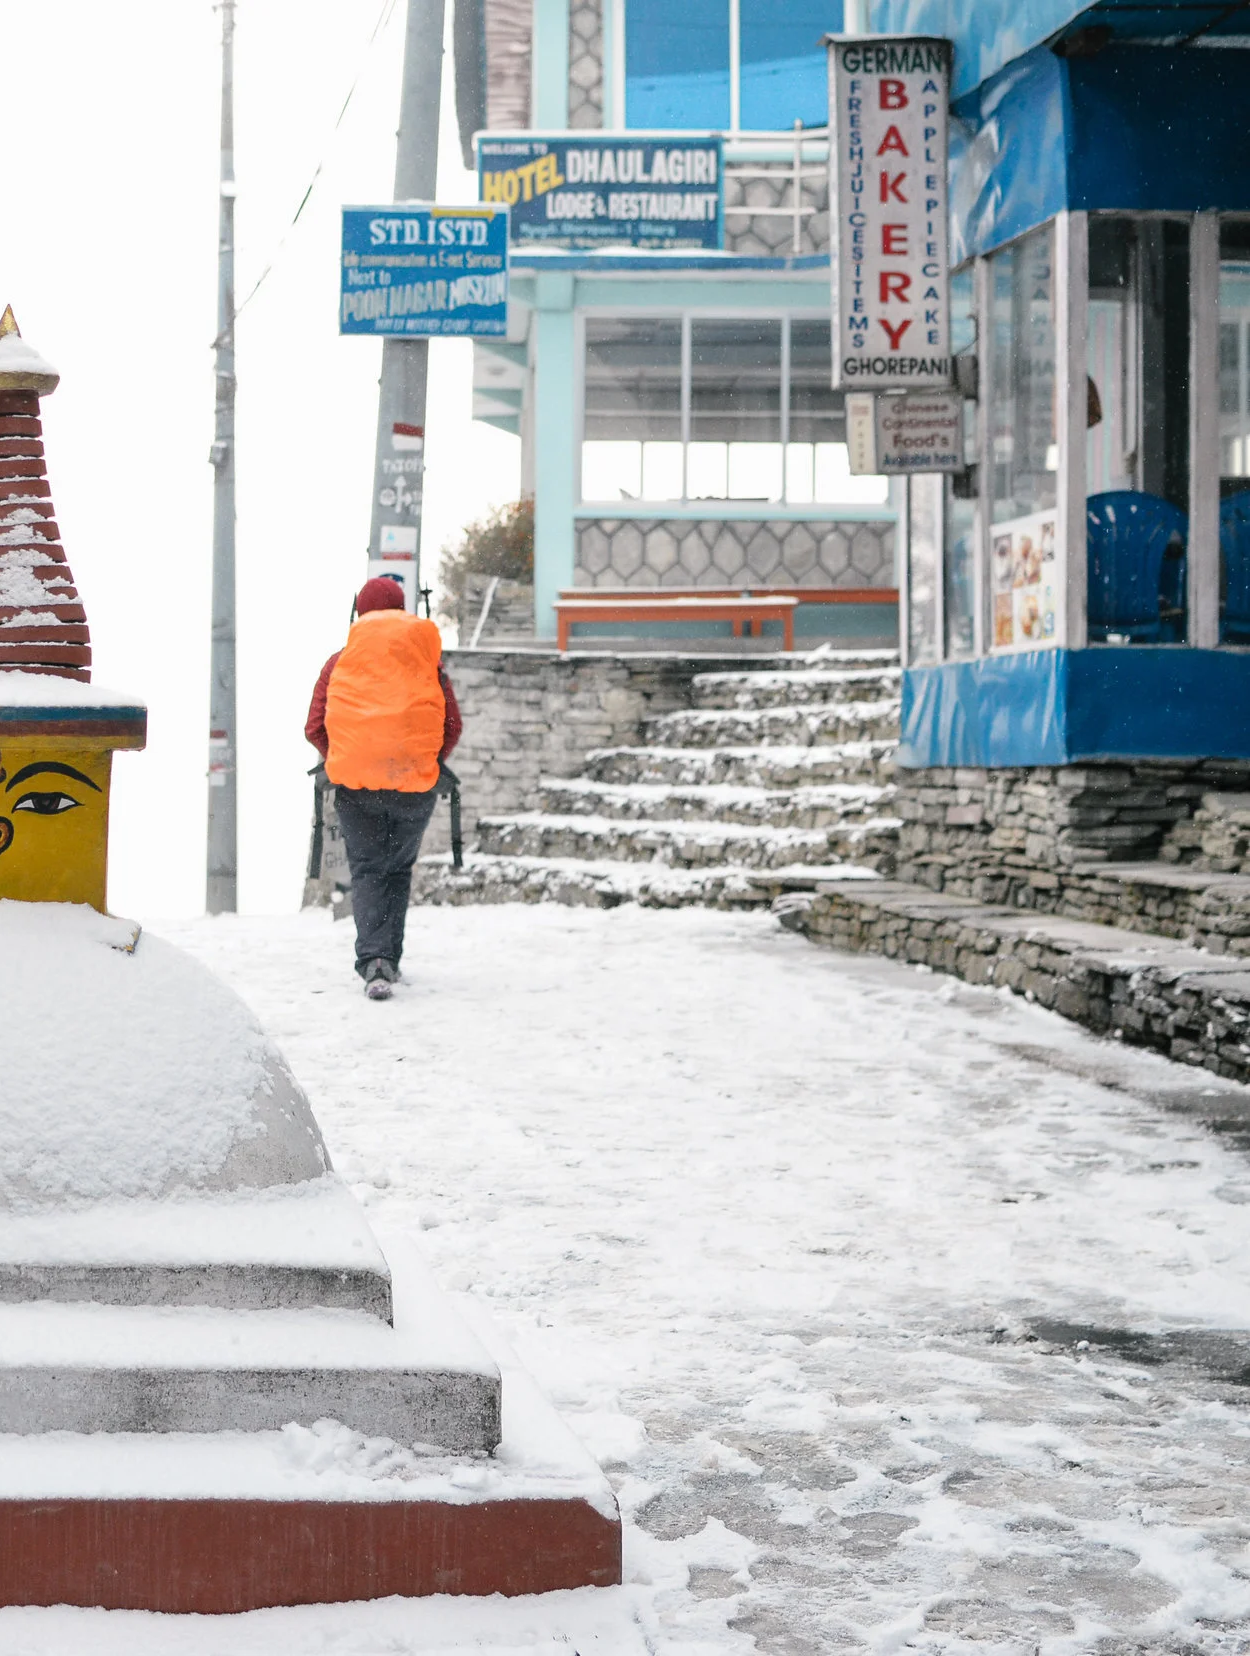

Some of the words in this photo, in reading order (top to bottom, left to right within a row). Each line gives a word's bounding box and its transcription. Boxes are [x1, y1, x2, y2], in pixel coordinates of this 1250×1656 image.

[842, 46, 943, 75] GERMAN
[482, 153, 565, 205] HOTEL
[565, 149, 718, 185] DHAULAGIRI
[545, 191, 596, 220] LODGE
[607, 191, 719, 221] RESTAURANT
[876, 78, 911, 351] BAKERY
[465, 250, 503, 269] Service
[348, 269, 376, 286] Next
[379, 270, 392, 286] to
[843, 356, 949, 377] GHOREPANI
[882, 417, 959, 431] Continental
